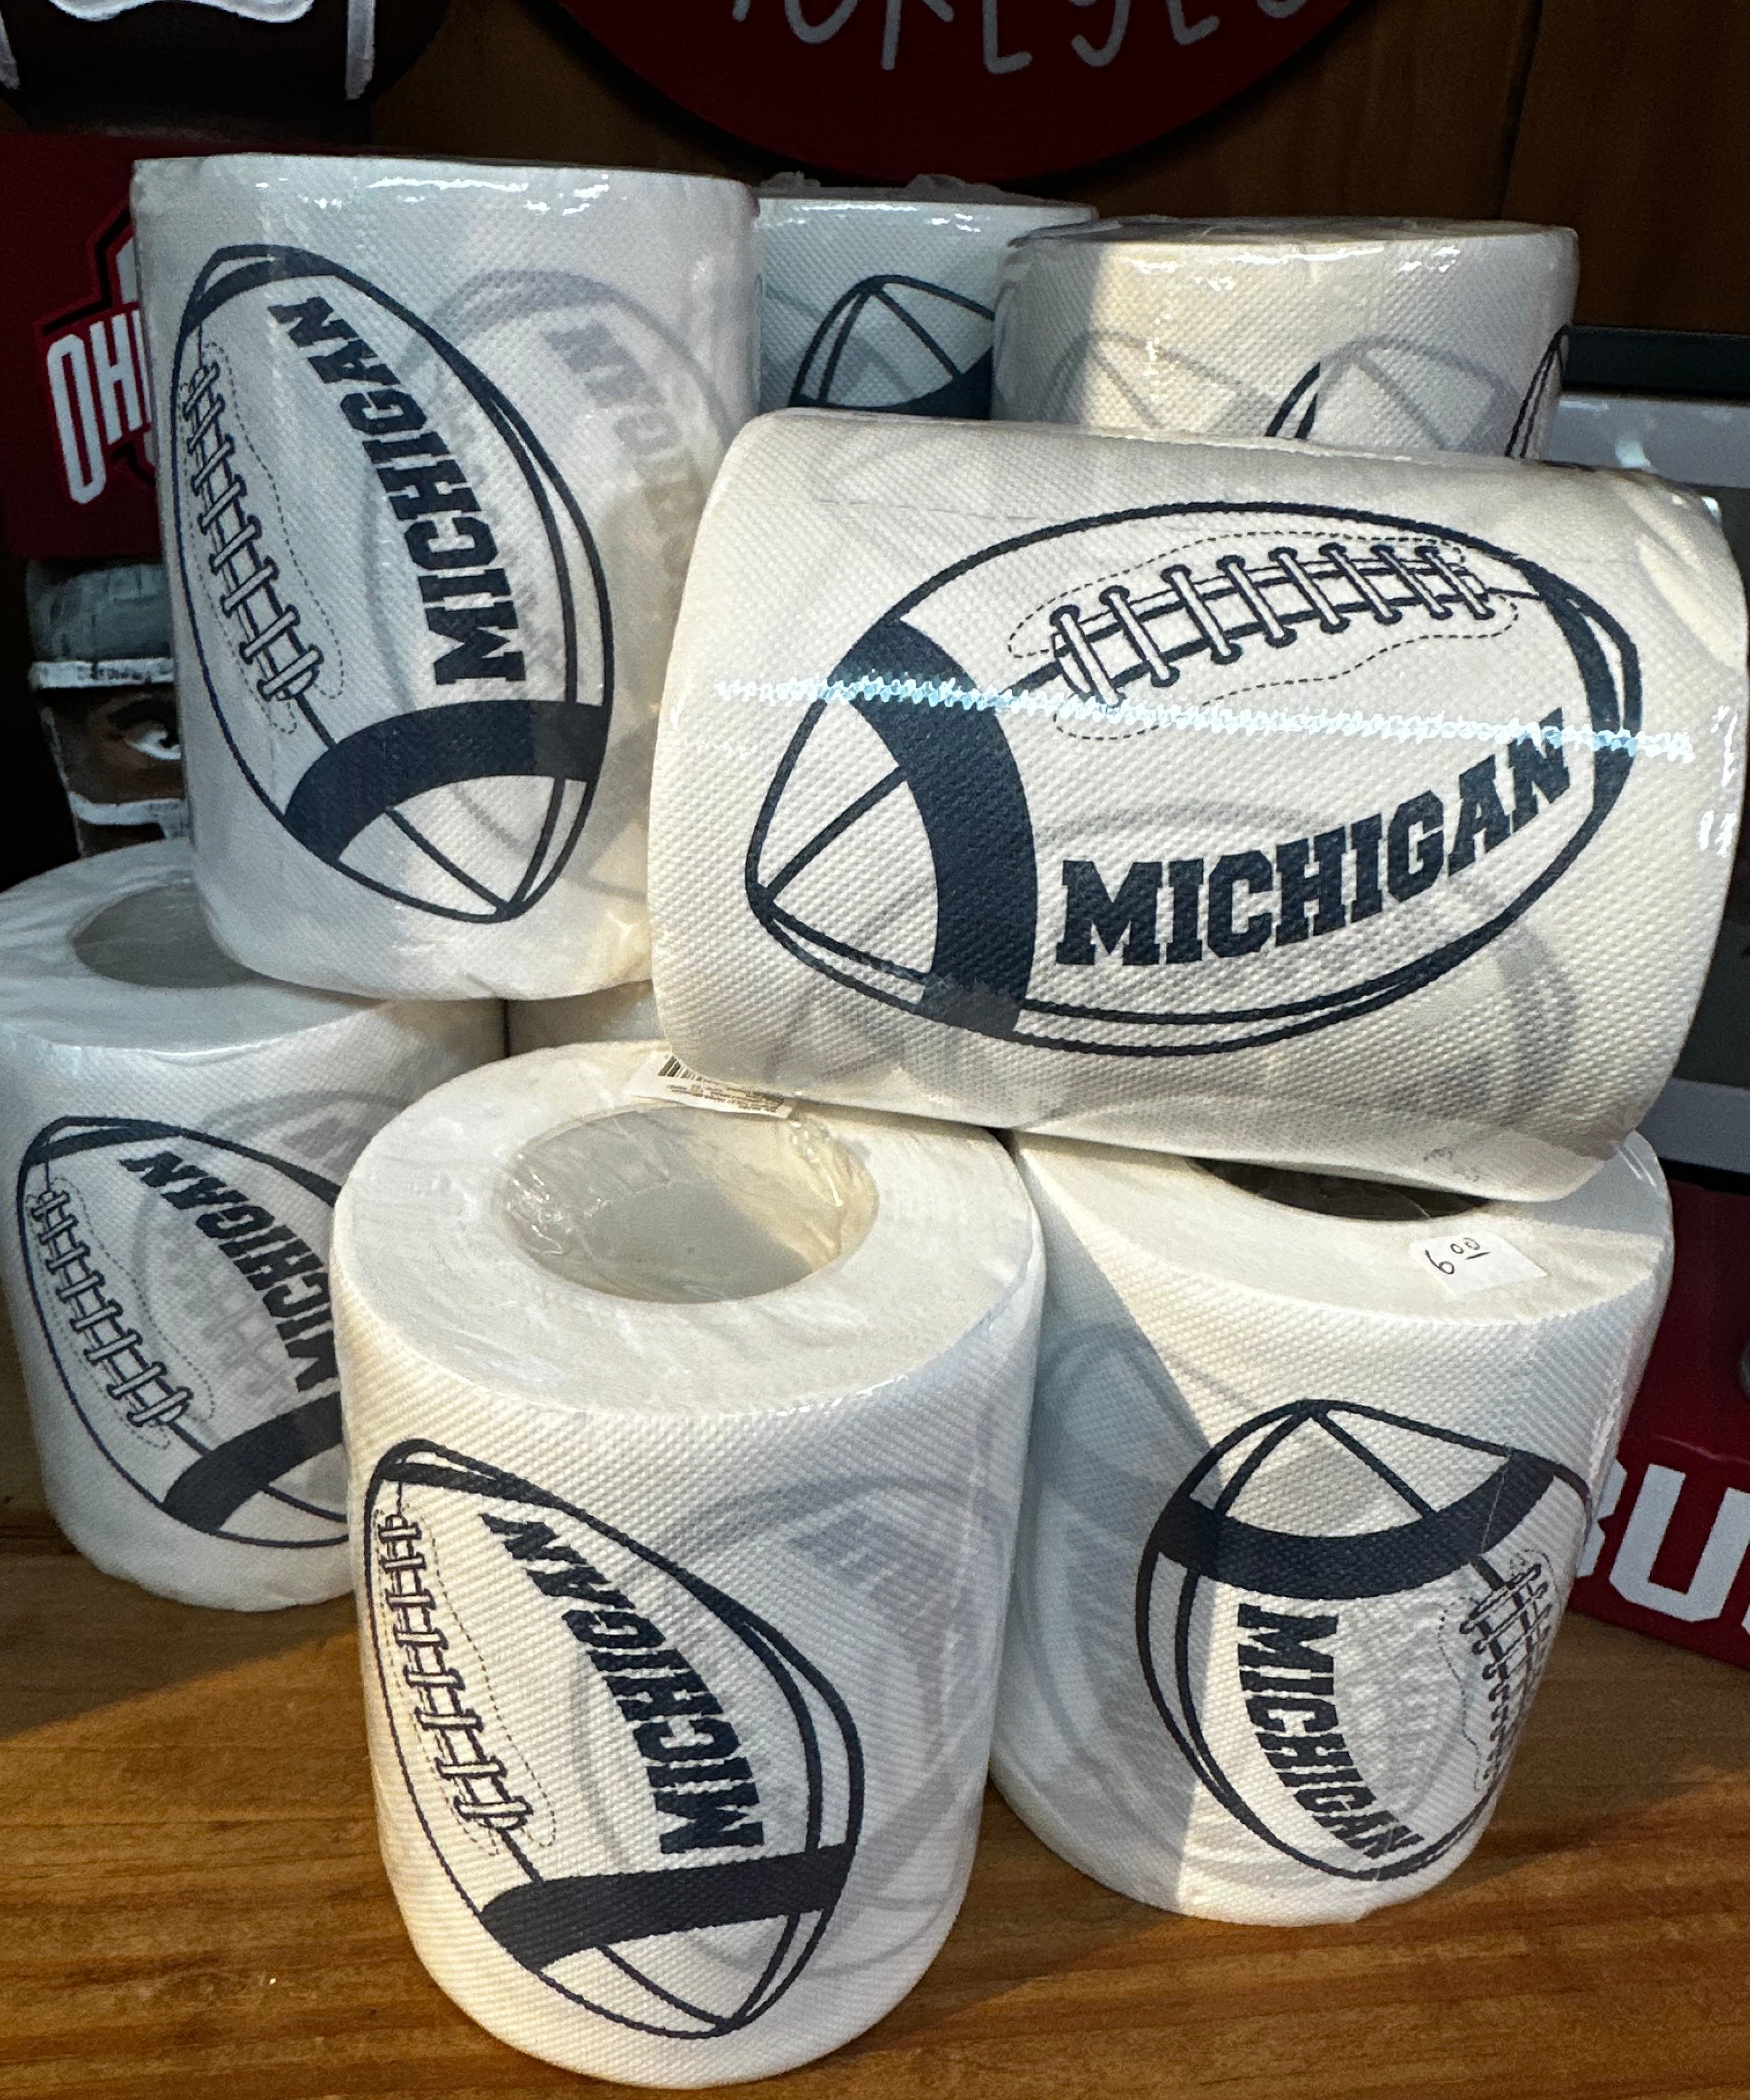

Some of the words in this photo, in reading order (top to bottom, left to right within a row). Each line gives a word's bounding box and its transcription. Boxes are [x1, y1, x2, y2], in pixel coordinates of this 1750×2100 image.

[267, 296, 526, 685] MICHIGAN
[1056, 707, 1571, 965] MICHIGAN
[479, 1512, 764, 1854] MICHIGAN
[1237, 1603, 1425, 1859] MICHIGAN
